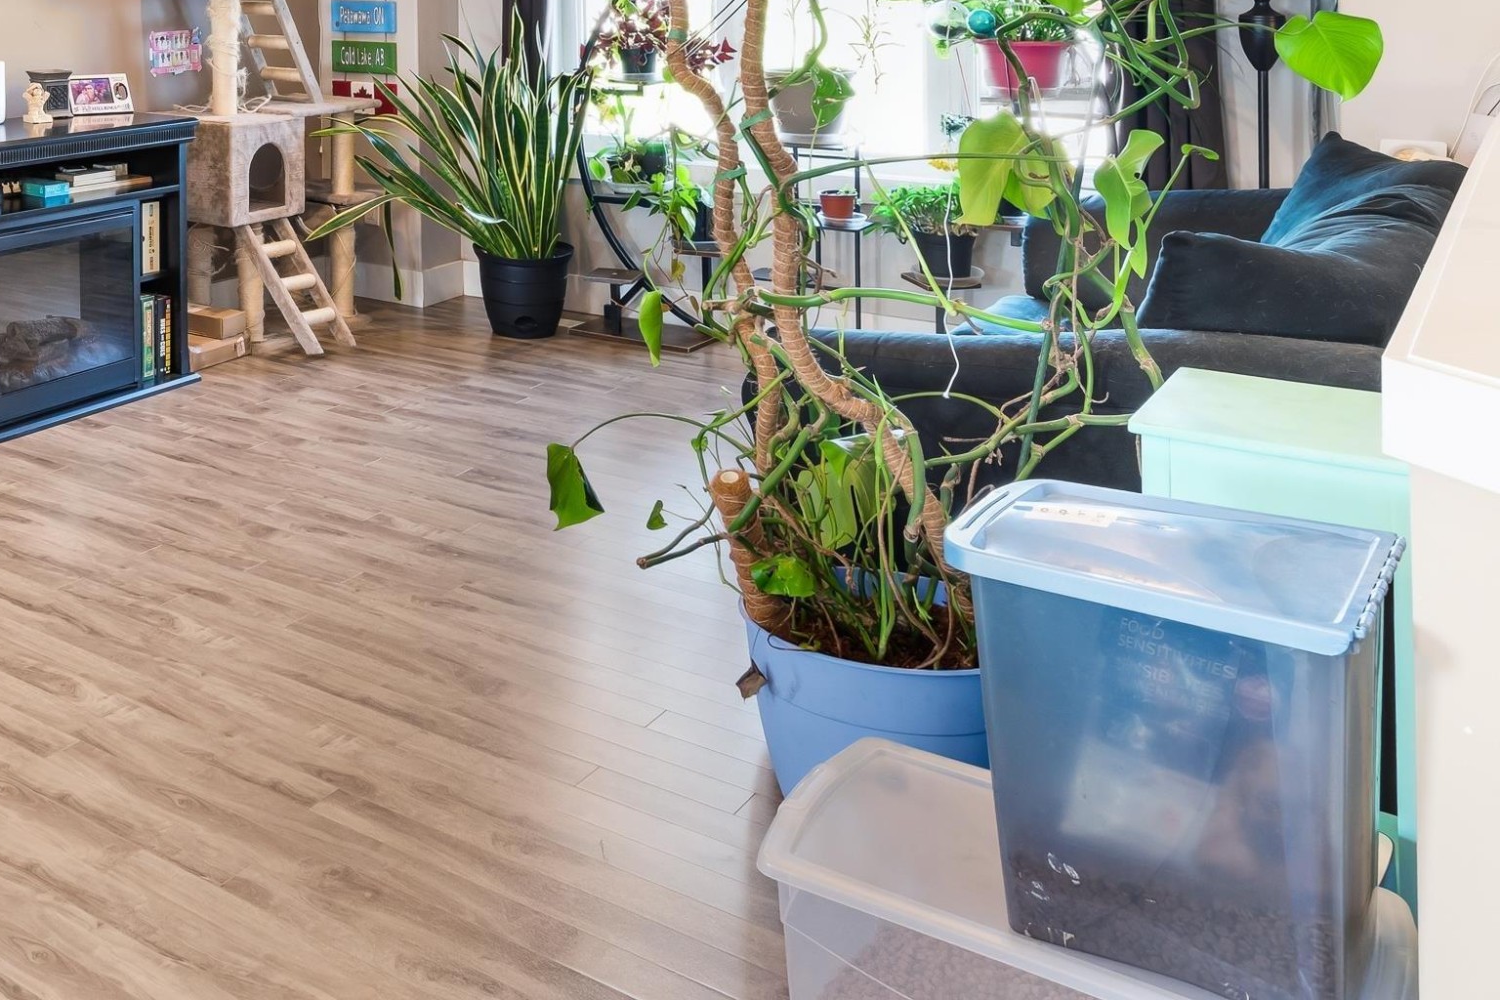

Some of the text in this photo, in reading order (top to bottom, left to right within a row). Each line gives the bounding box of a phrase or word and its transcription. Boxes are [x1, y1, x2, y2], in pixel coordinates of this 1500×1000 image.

[373, 6, 384, 25] ON
[341, 46, 355, 65] Cold
[375, 47, 385, 66] AB
